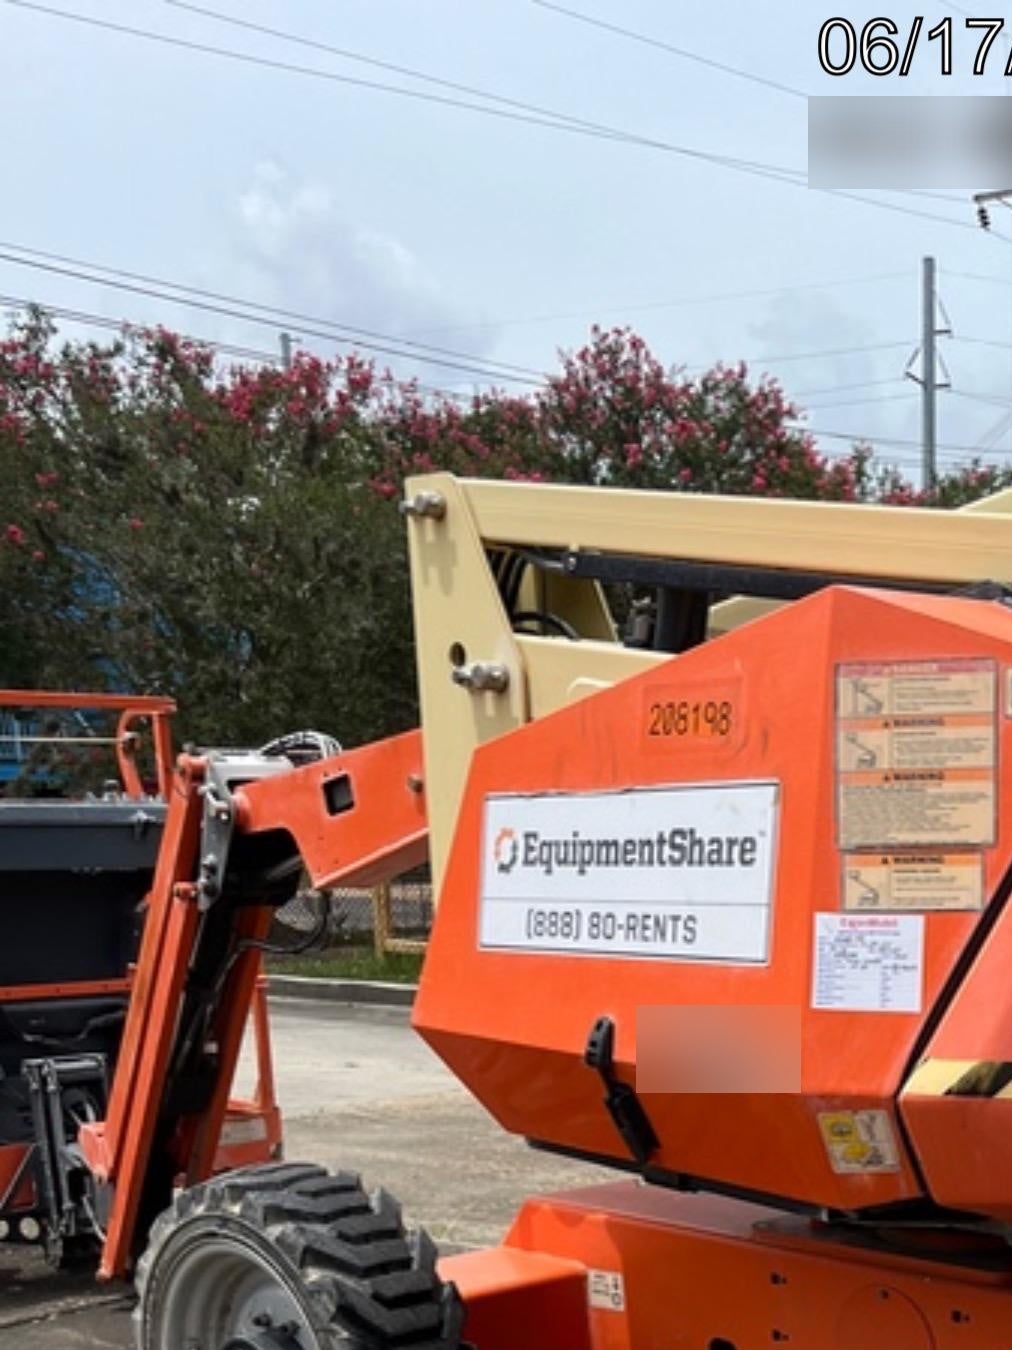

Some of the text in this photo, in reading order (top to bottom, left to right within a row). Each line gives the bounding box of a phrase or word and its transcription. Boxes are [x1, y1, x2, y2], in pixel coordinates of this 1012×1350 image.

[522, 827, 757, 875] EquipmentShare
[527, 909, 697, 944] (888) 80-RENTS
